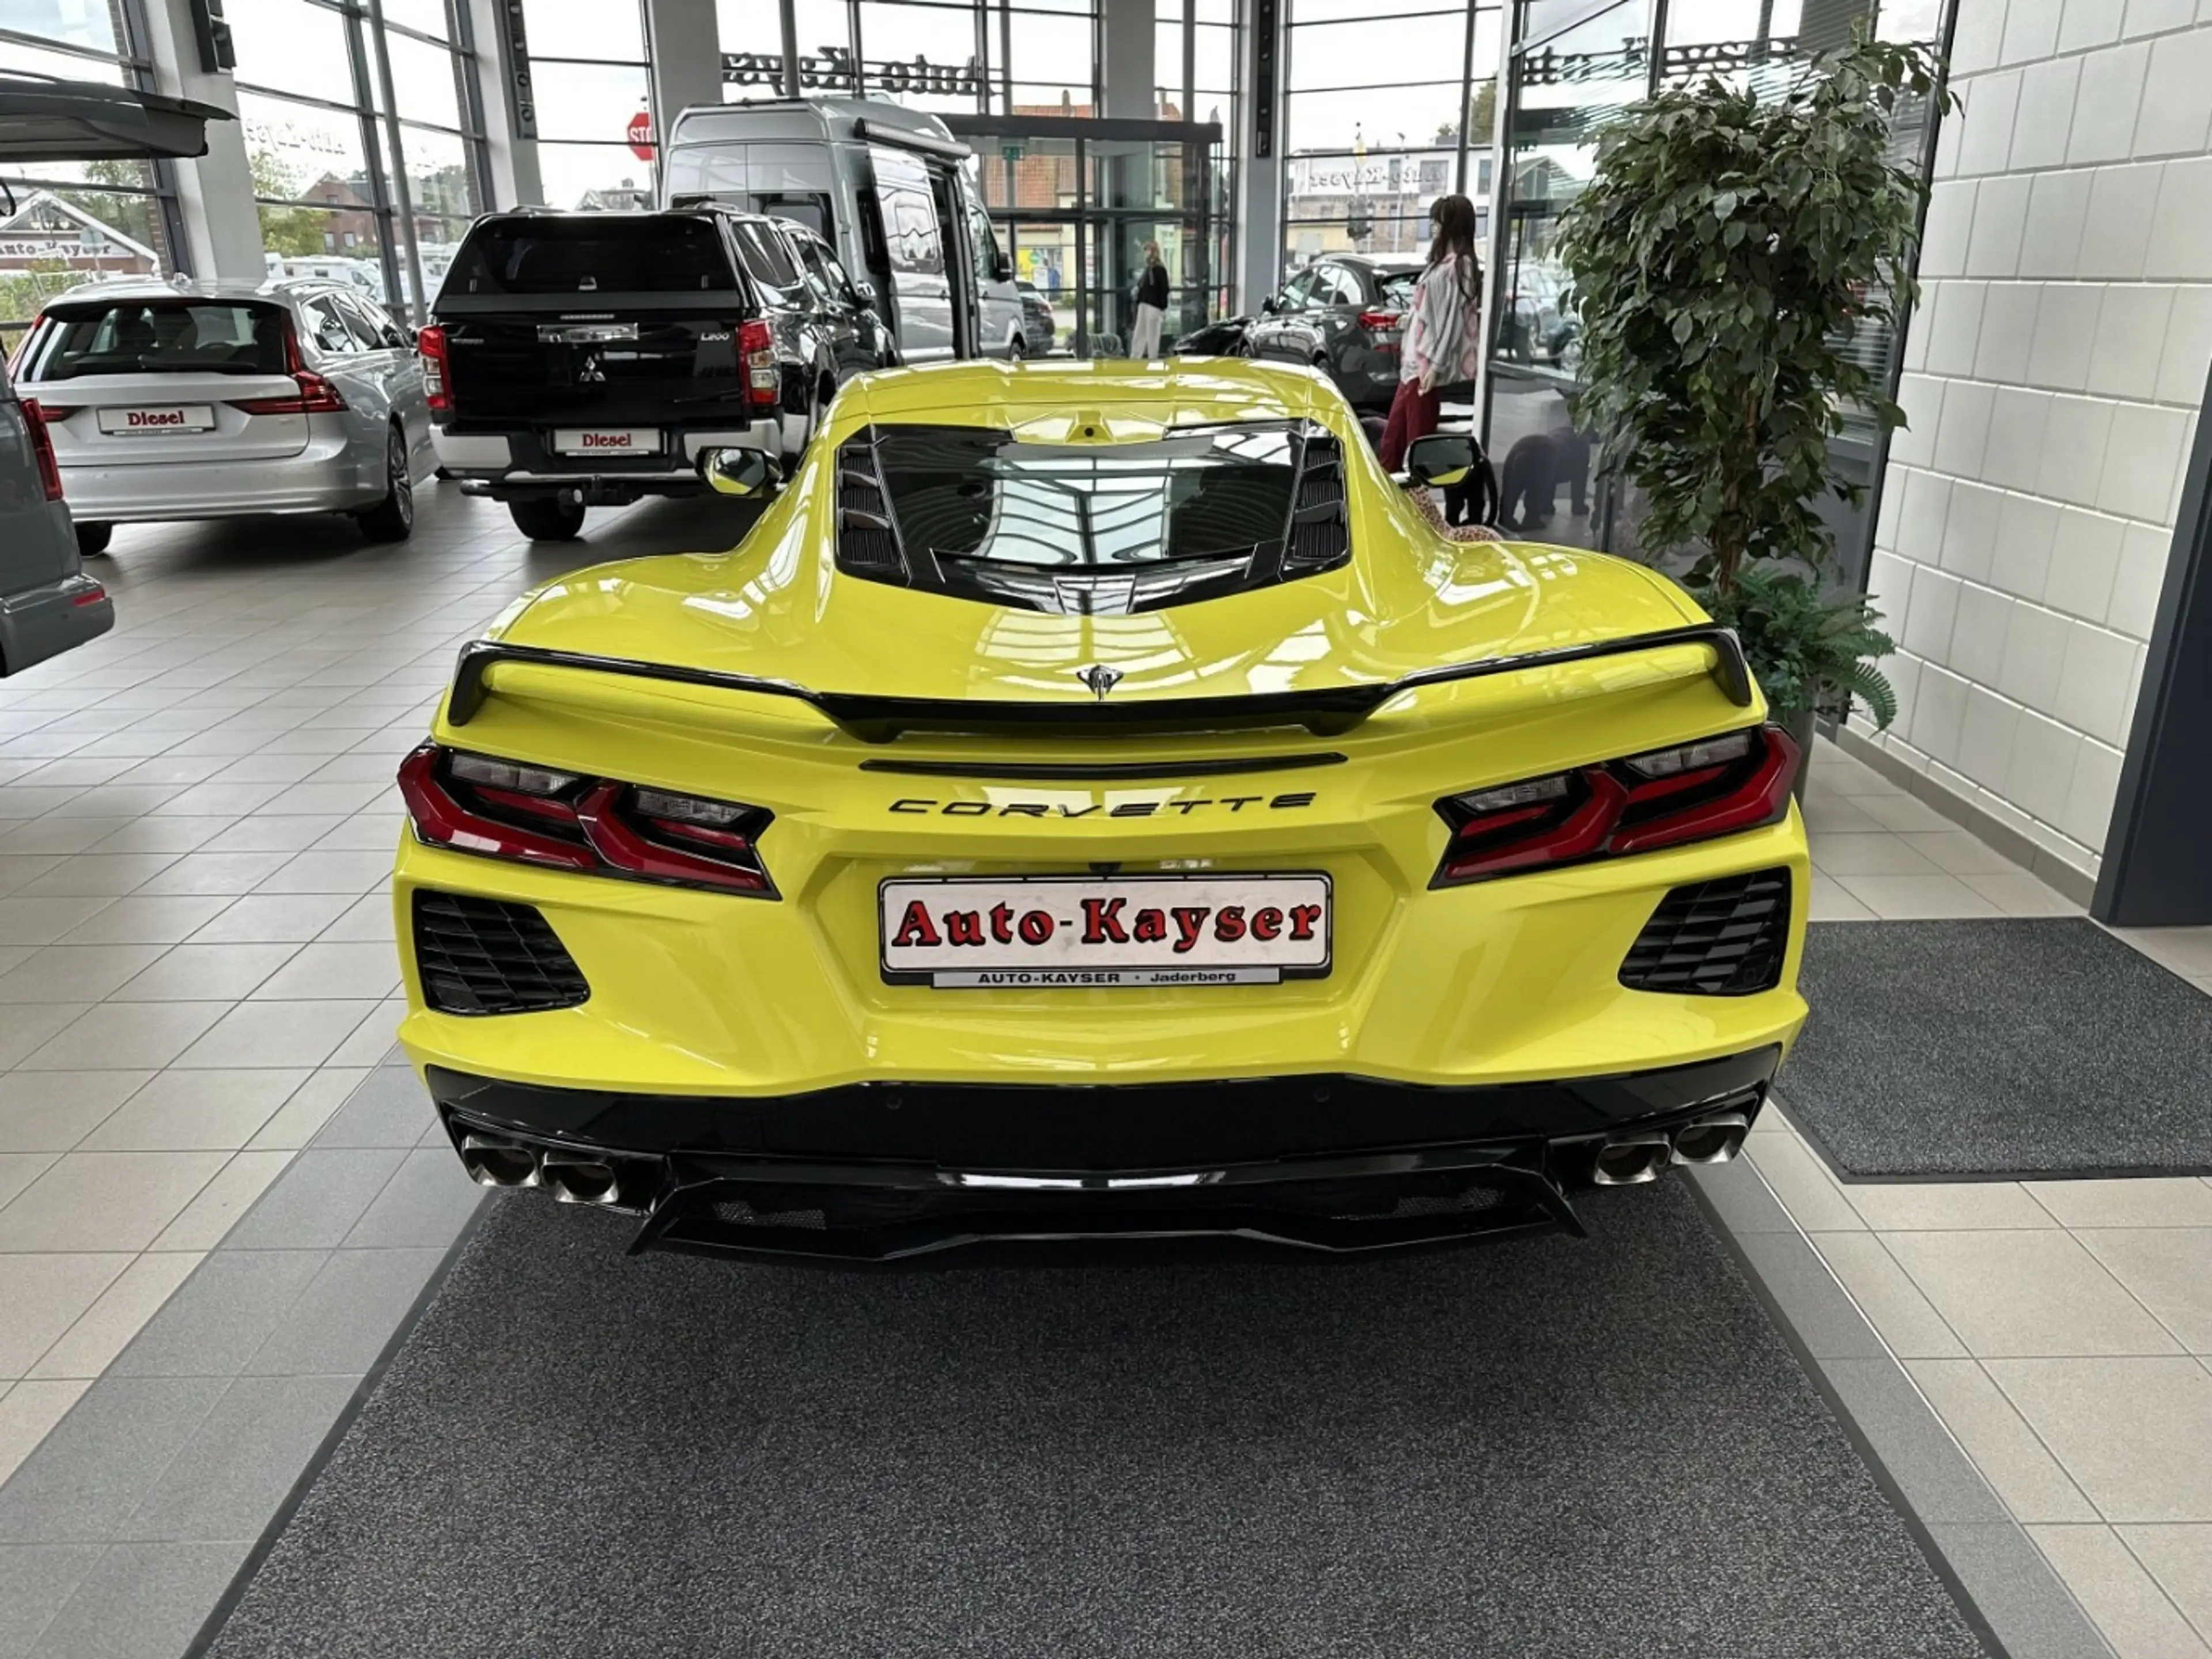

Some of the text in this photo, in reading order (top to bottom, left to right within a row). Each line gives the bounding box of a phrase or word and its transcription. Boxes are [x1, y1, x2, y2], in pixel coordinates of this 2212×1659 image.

[888, 792, 1317, 817] CORVETTE
[891, 897, 1322, 953] Auto-Kayser
[978, 971, 1237, 984] AUTO-KAYSER Jaderberg
